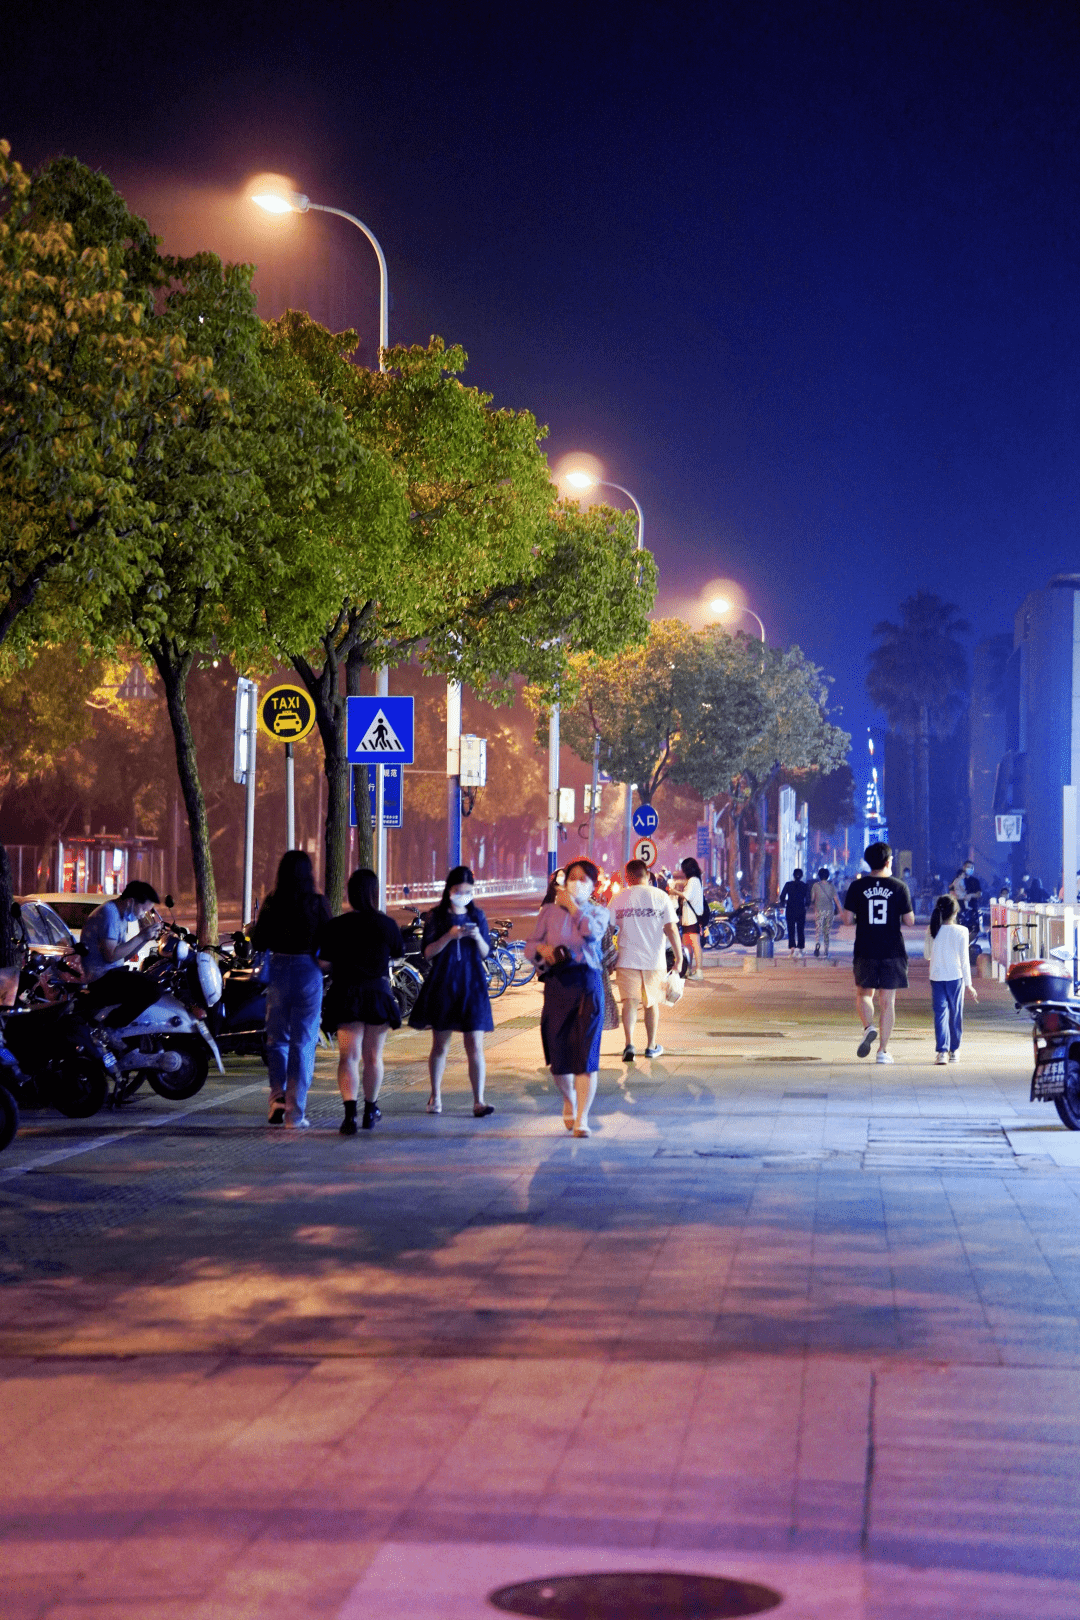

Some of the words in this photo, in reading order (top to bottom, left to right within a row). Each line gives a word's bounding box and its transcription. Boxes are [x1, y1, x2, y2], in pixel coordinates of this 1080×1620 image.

[271, 696, 300, 710] TAXI
[635, 815, 656, 827] 入口
[641, 844, 650, 862] 5
[863, 887, 893, 899] GEORGE
[868, 899, 888, 925] 13
